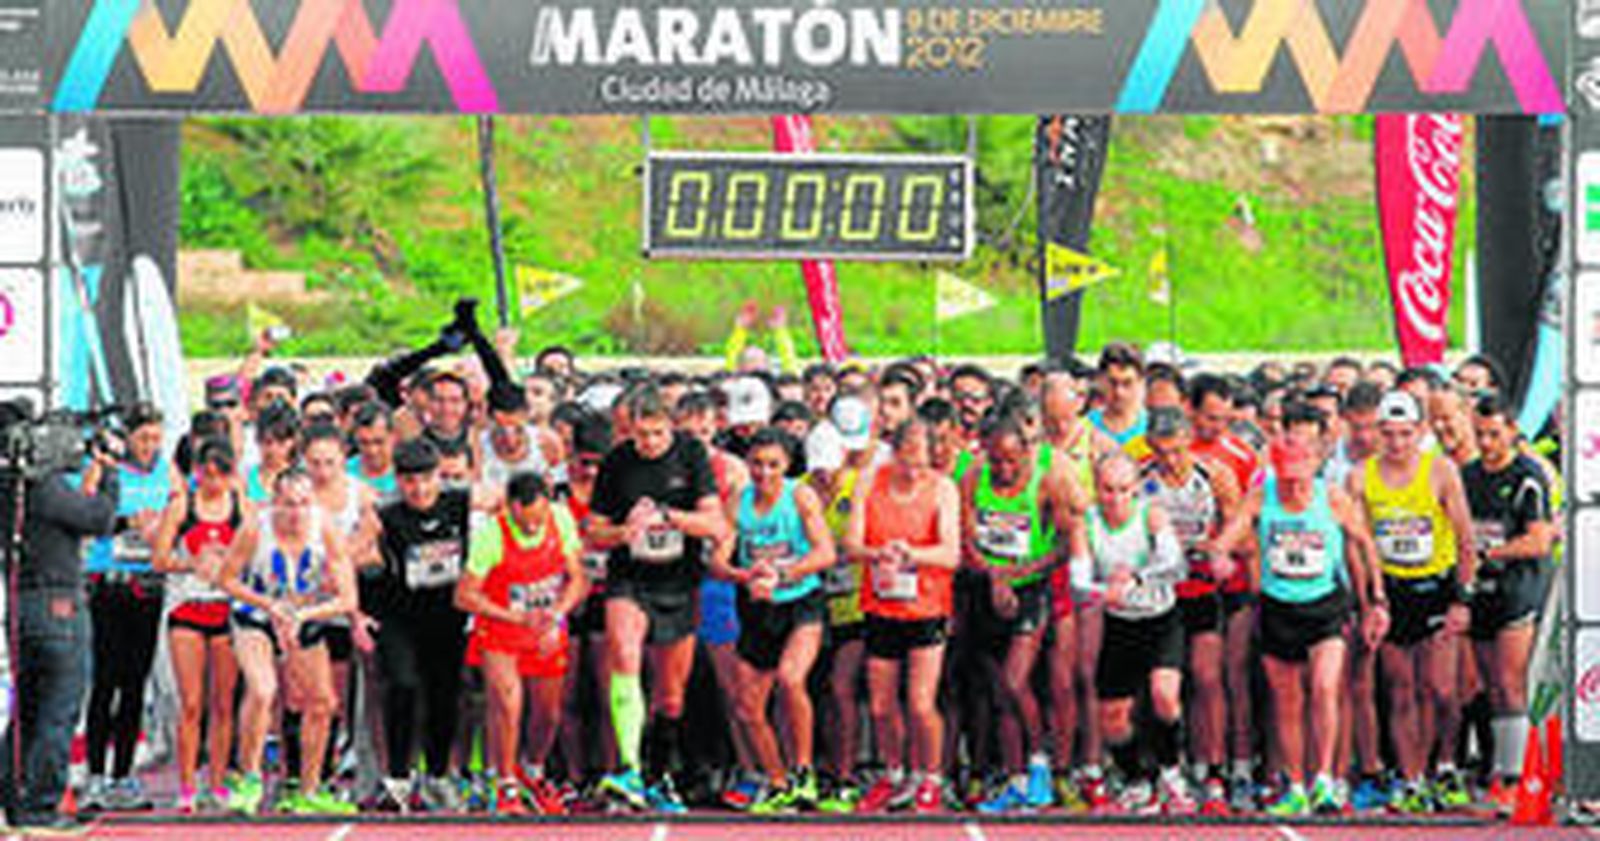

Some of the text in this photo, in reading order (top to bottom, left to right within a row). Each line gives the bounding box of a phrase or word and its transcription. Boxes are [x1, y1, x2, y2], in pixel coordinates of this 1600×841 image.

[530, 0, 902, 67] MARATÓN
[906, 36, 985, 69] 2012
[601, 76, 831, 107] Ciudad de Málaga
